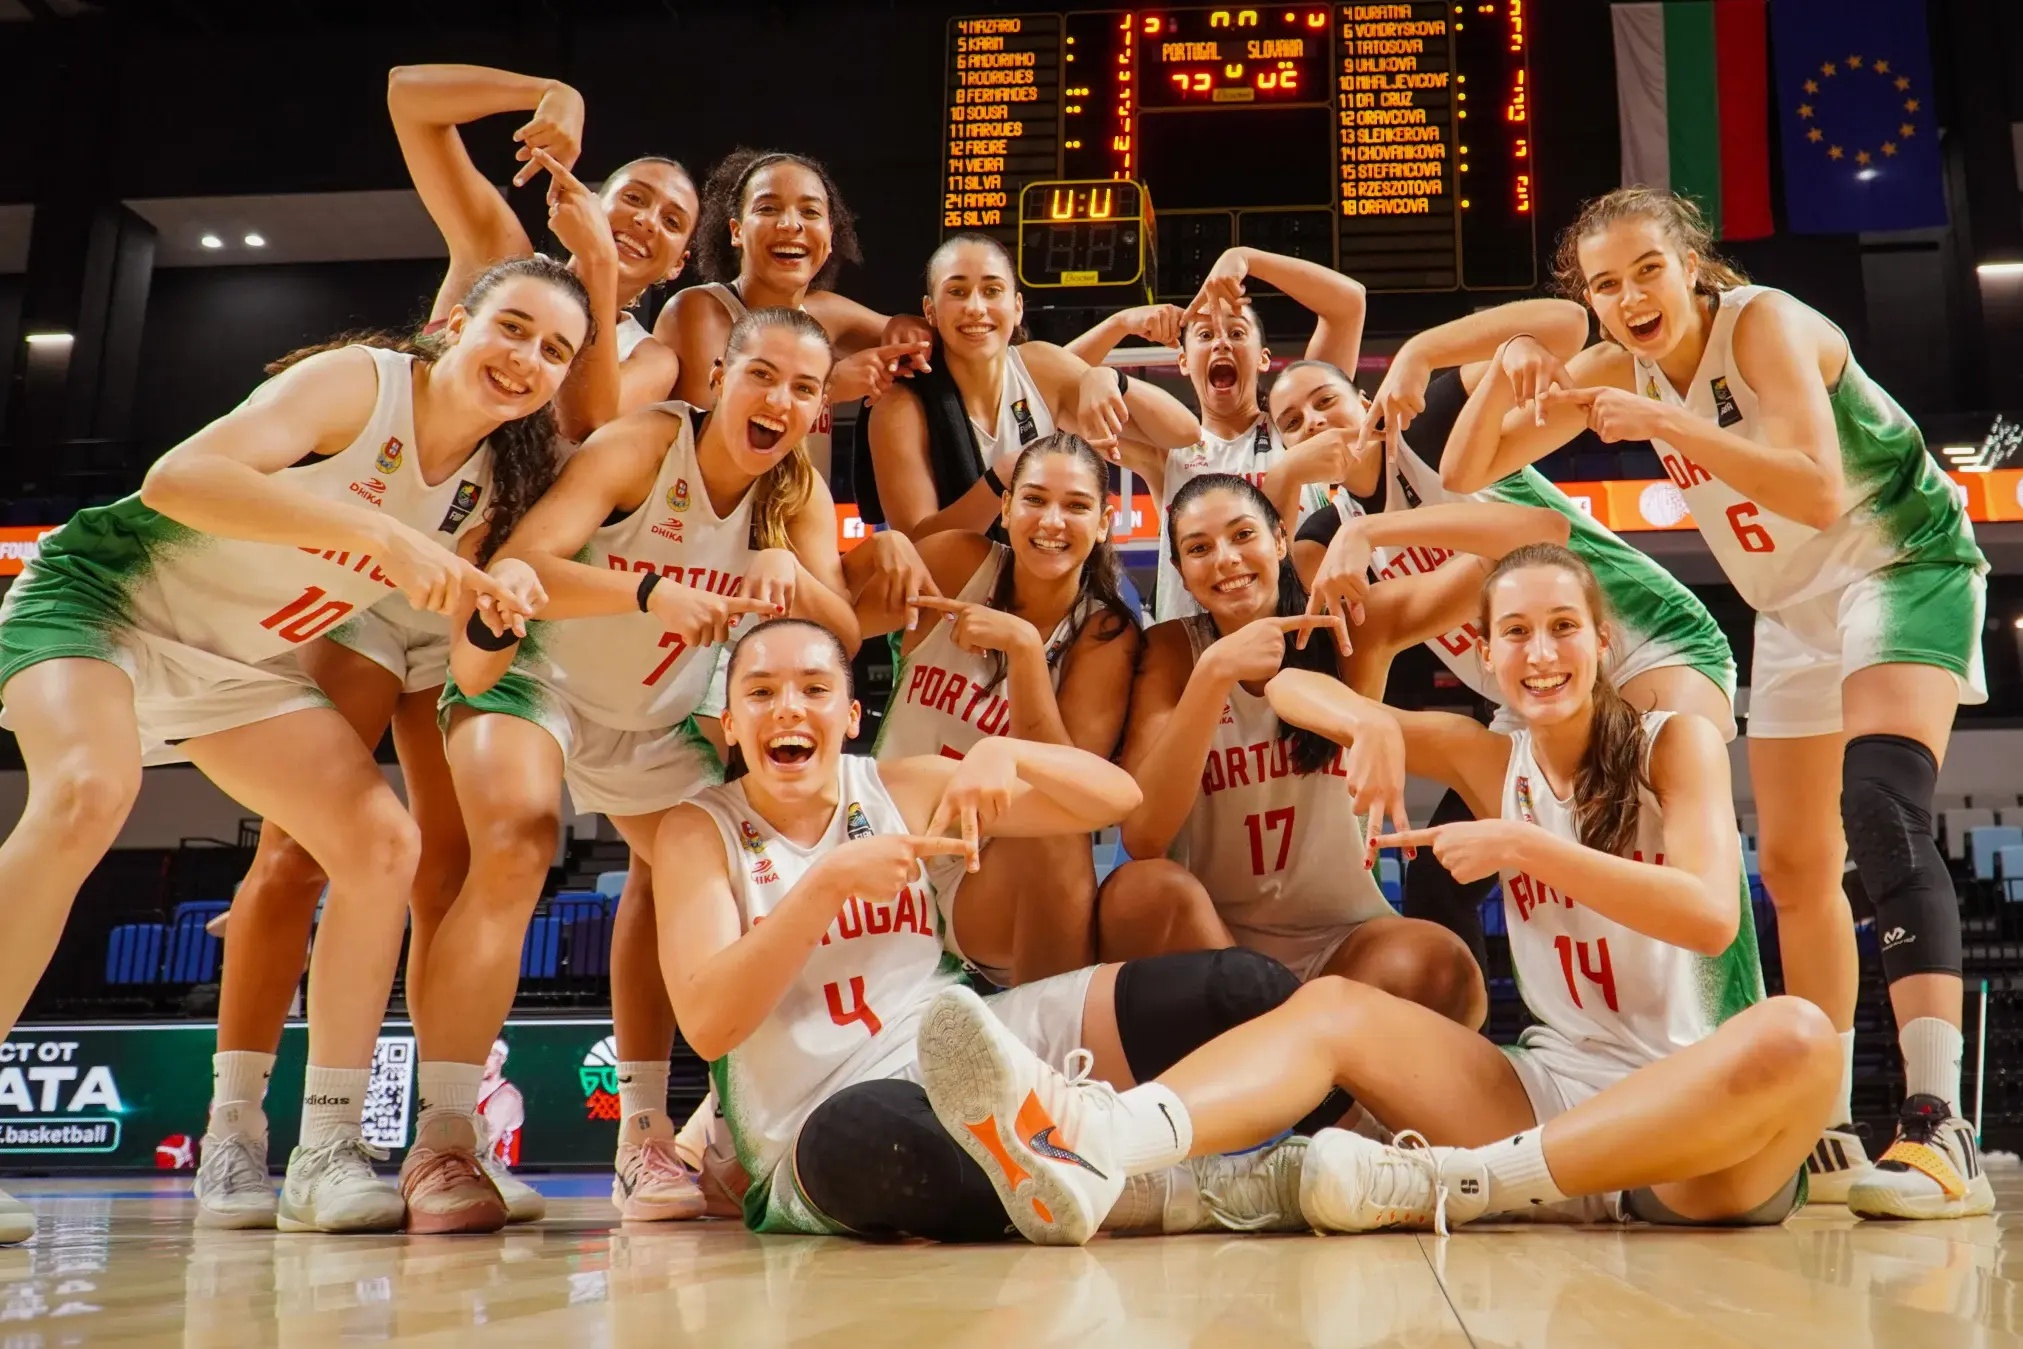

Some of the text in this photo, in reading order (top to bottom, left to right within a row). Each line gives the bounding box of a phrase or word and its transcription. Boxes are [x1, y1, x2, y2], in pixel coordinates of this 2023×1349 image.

[1343, 6, 1353, 20] 4
[957, 20, 967, 34] 4
[1343, 24, 1353, 39] 6
[957, 37, 967, 52] 5
[1162, 41, 1222, 62] PORTUGAL
[1247, 39, 1304, 59] SLOVAKIA
[1344, 38, 1423, 55] 7 TATOSOVA
[957, 52, 1035, 69] 6 ANDORINHO
[1344, 56, 1417, 73] 9 UHLIKOVA
[957, 69, 1034, 86] 7 RODRIGUES
[1339, 75, 1354, 91] 10
[956, 86, 1038, 104] 8 FERNANDES
[1339, 91, 1414, 108] 11 DA CRUZ
[950, 105, 1008, 121] 10 SOUSA
[1340, 108, 1426, 126] 12 ORAVCOVA
[950, 121, 1023, 138] 11 MARQUES
[1340, 128, 1355, 144] 13
[950, 139, 1008, 156] 12 FREIRE
[1340, 146, 1356, 162] 14
[949, 157, 1004, 173] 14 VIEIRA
[1341, 163, 1356, 179] 15
[948, 174, 1001, 191] 17 SILVA
[1341, 179, 1442, 197] 16 RZESZOTOVA
[945, 192, 1007, 209] 24 AMARO
[1341, 197, 1429, 215] 18 ORAVCOVA
[945, 210, 1000, 227] 26 SILVA
[349, 481, 383, 508] DHIKA
[651, 524, 684, 543] DHIKA
[1726, 501, 1776, 553] 6
[259, 585, 354, 644] 10
[642, 631, 688, 687] 7
[1243, 805, 1296, 876] 17
[1554, 935, 1620, 1013] 14
[823, 974, 883, 1038] 4
[0, 1124, 107, 1144] .basketball
